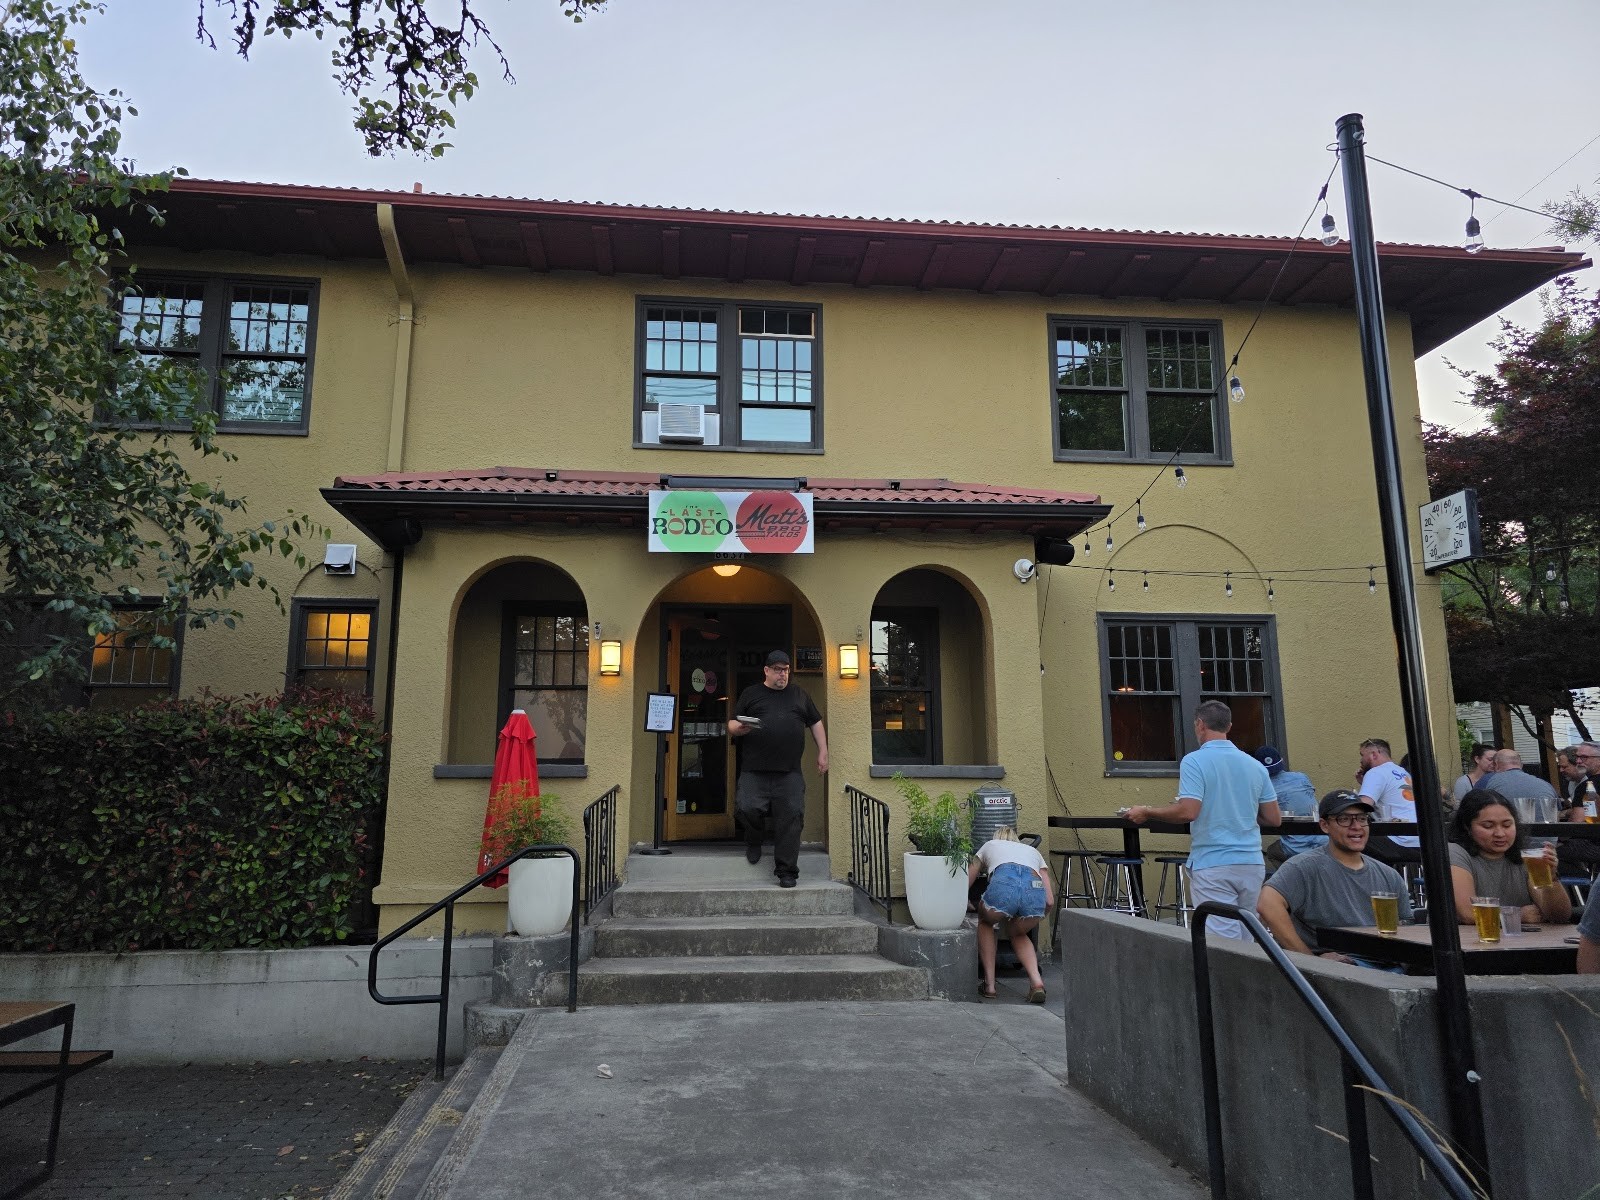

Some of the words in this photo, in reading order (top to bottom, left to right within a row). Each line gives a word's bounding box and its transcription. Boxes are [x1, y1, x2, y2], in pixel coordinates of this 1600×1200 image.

[1444, 499, 1451, 508] 60
[669, 508, 715, 517] LAST
[1432, 505, 1439, 513] 40
[736, 503, 809, 530] Matt's
[652, 517, 734, 536] RODEO
[1425, 518, 1431, 527] 20
